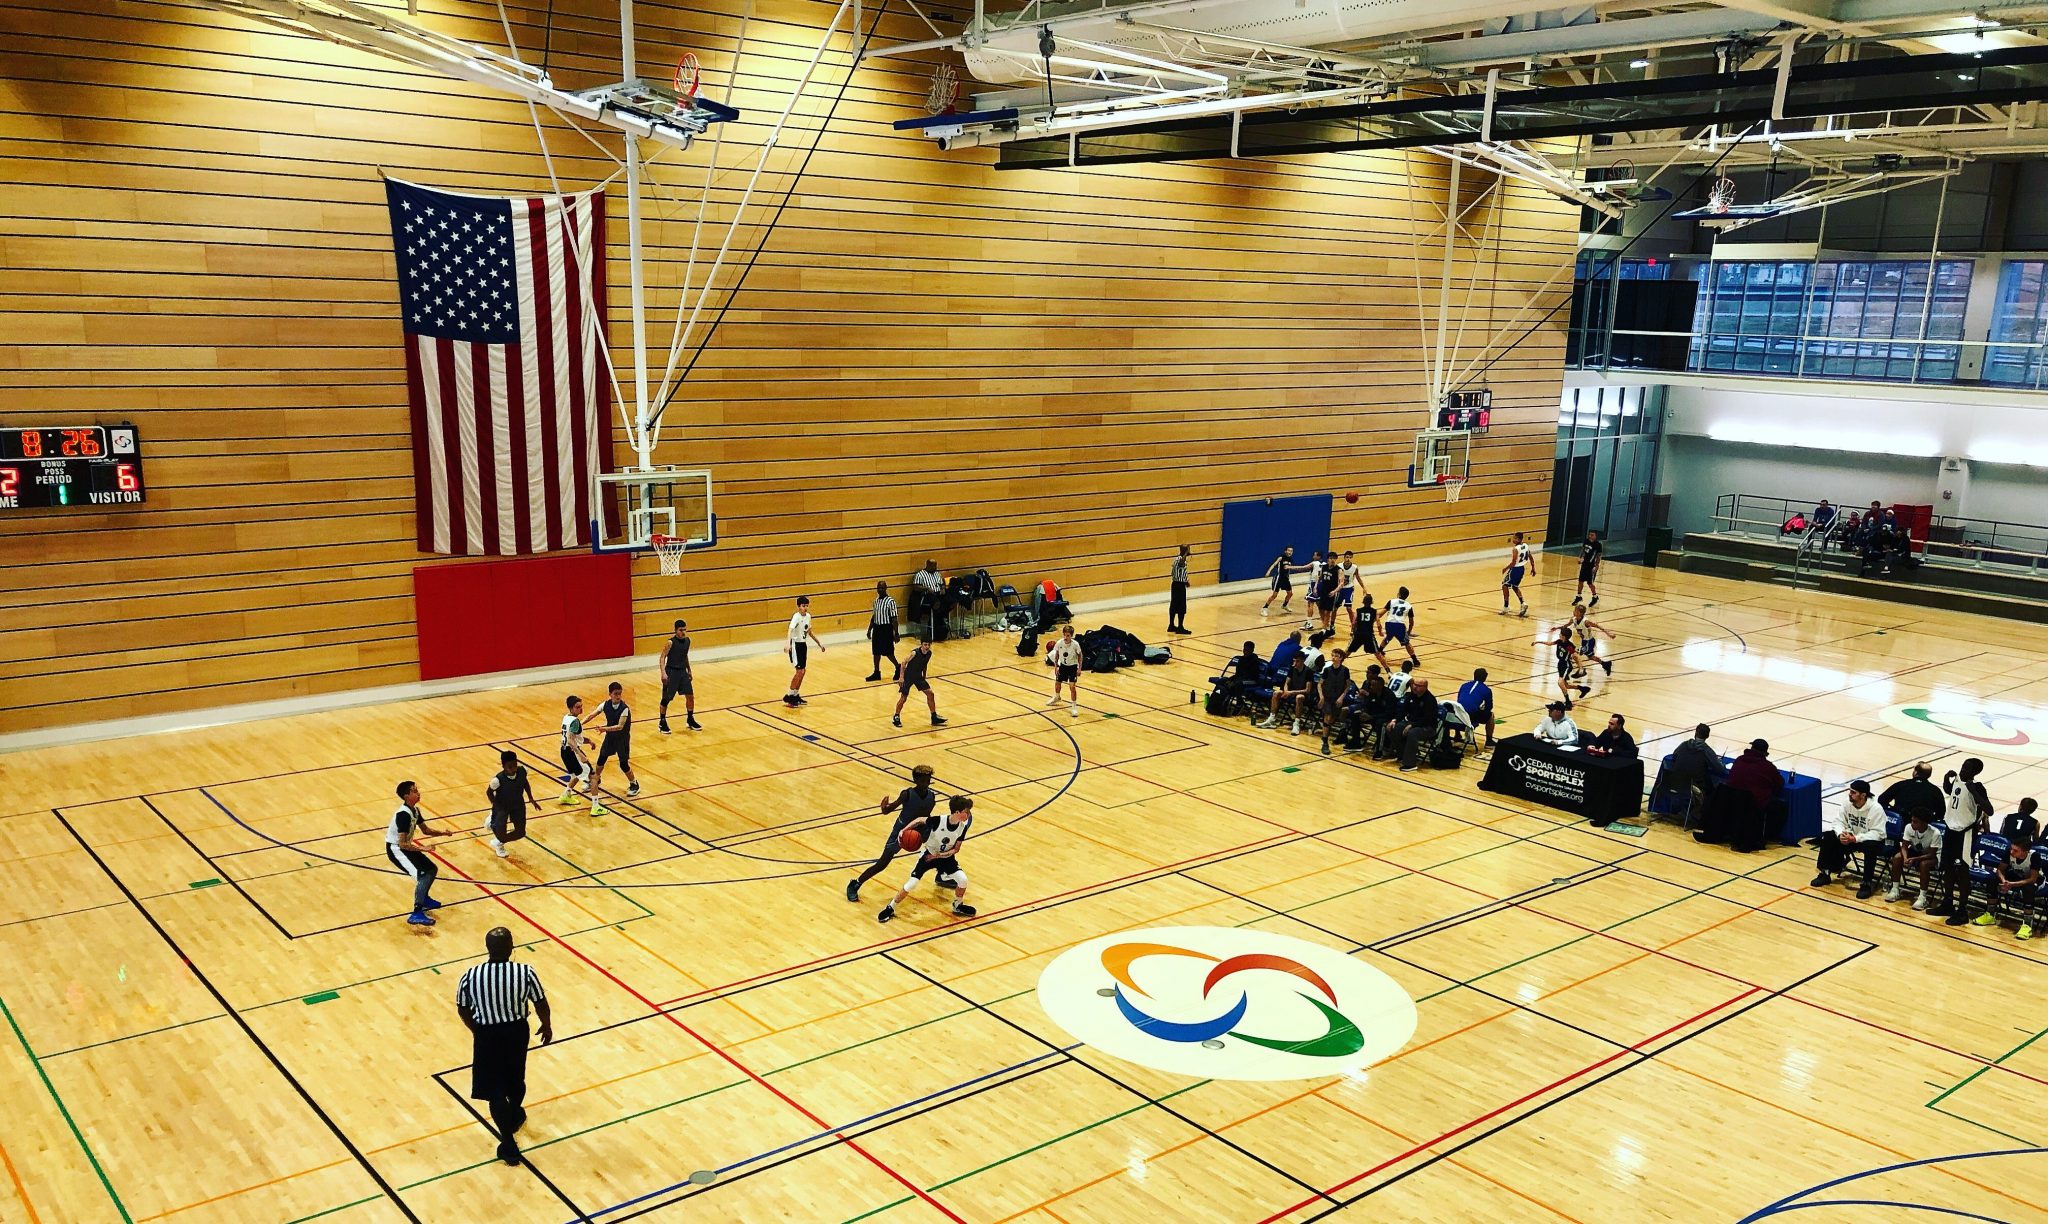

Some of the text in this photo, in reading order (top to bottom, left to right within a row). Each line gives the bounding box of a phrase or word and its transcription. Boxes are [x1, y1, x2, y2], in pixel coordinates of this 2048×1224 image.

[22, 430, 99, 456] 8:26
[40, 460, 67, 468] BONUS
[35, 474, 72, 485] PERIOD
[117, 464, 138, 490] 6
[89, 490, 141, 504] VISITOR
[1360, 612, 1371, 622] 13
[1526, 758, 1585, 778] CEDAR VALLEY
[1526, 766, 1584, 787] SPORTSPLEX
[1525, 781, 1583, 803] cvsportsplex.org
[1951, 796, 1959, 810] 21
